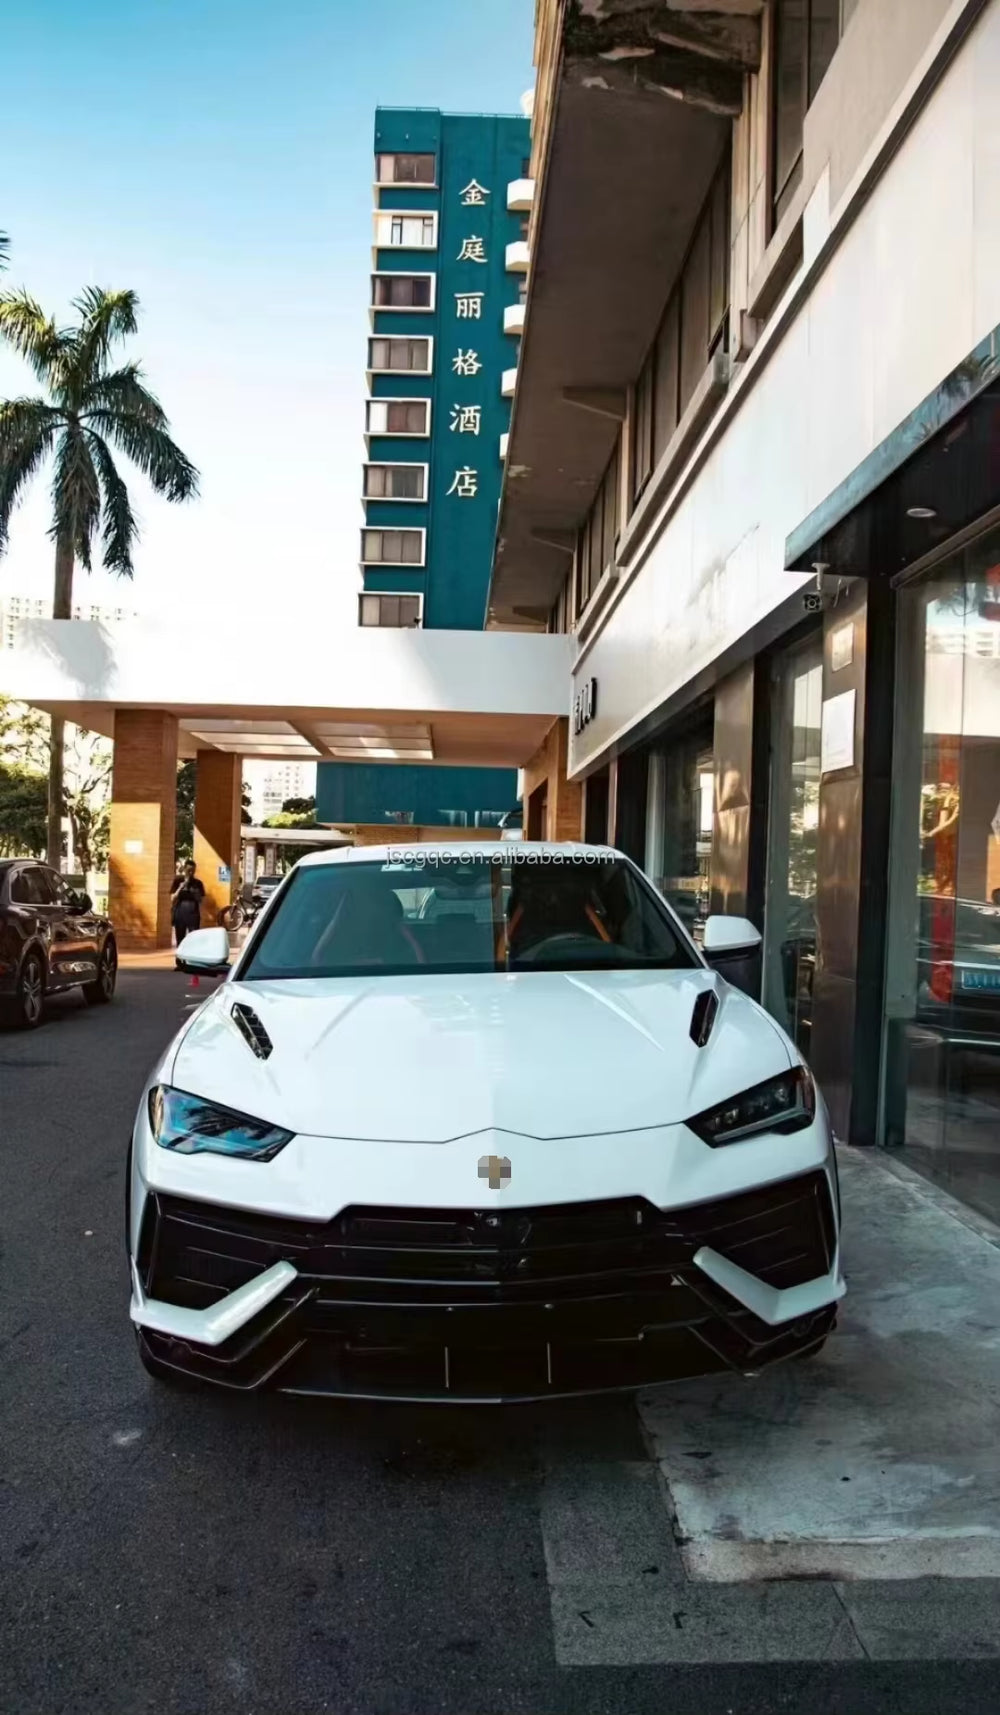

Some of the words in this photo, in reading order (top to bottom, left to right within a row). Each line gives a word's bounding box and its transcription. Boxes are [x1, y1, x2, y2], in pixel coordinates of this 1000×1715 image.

[446, 178, 490, 497] 金庭丽格酒店
